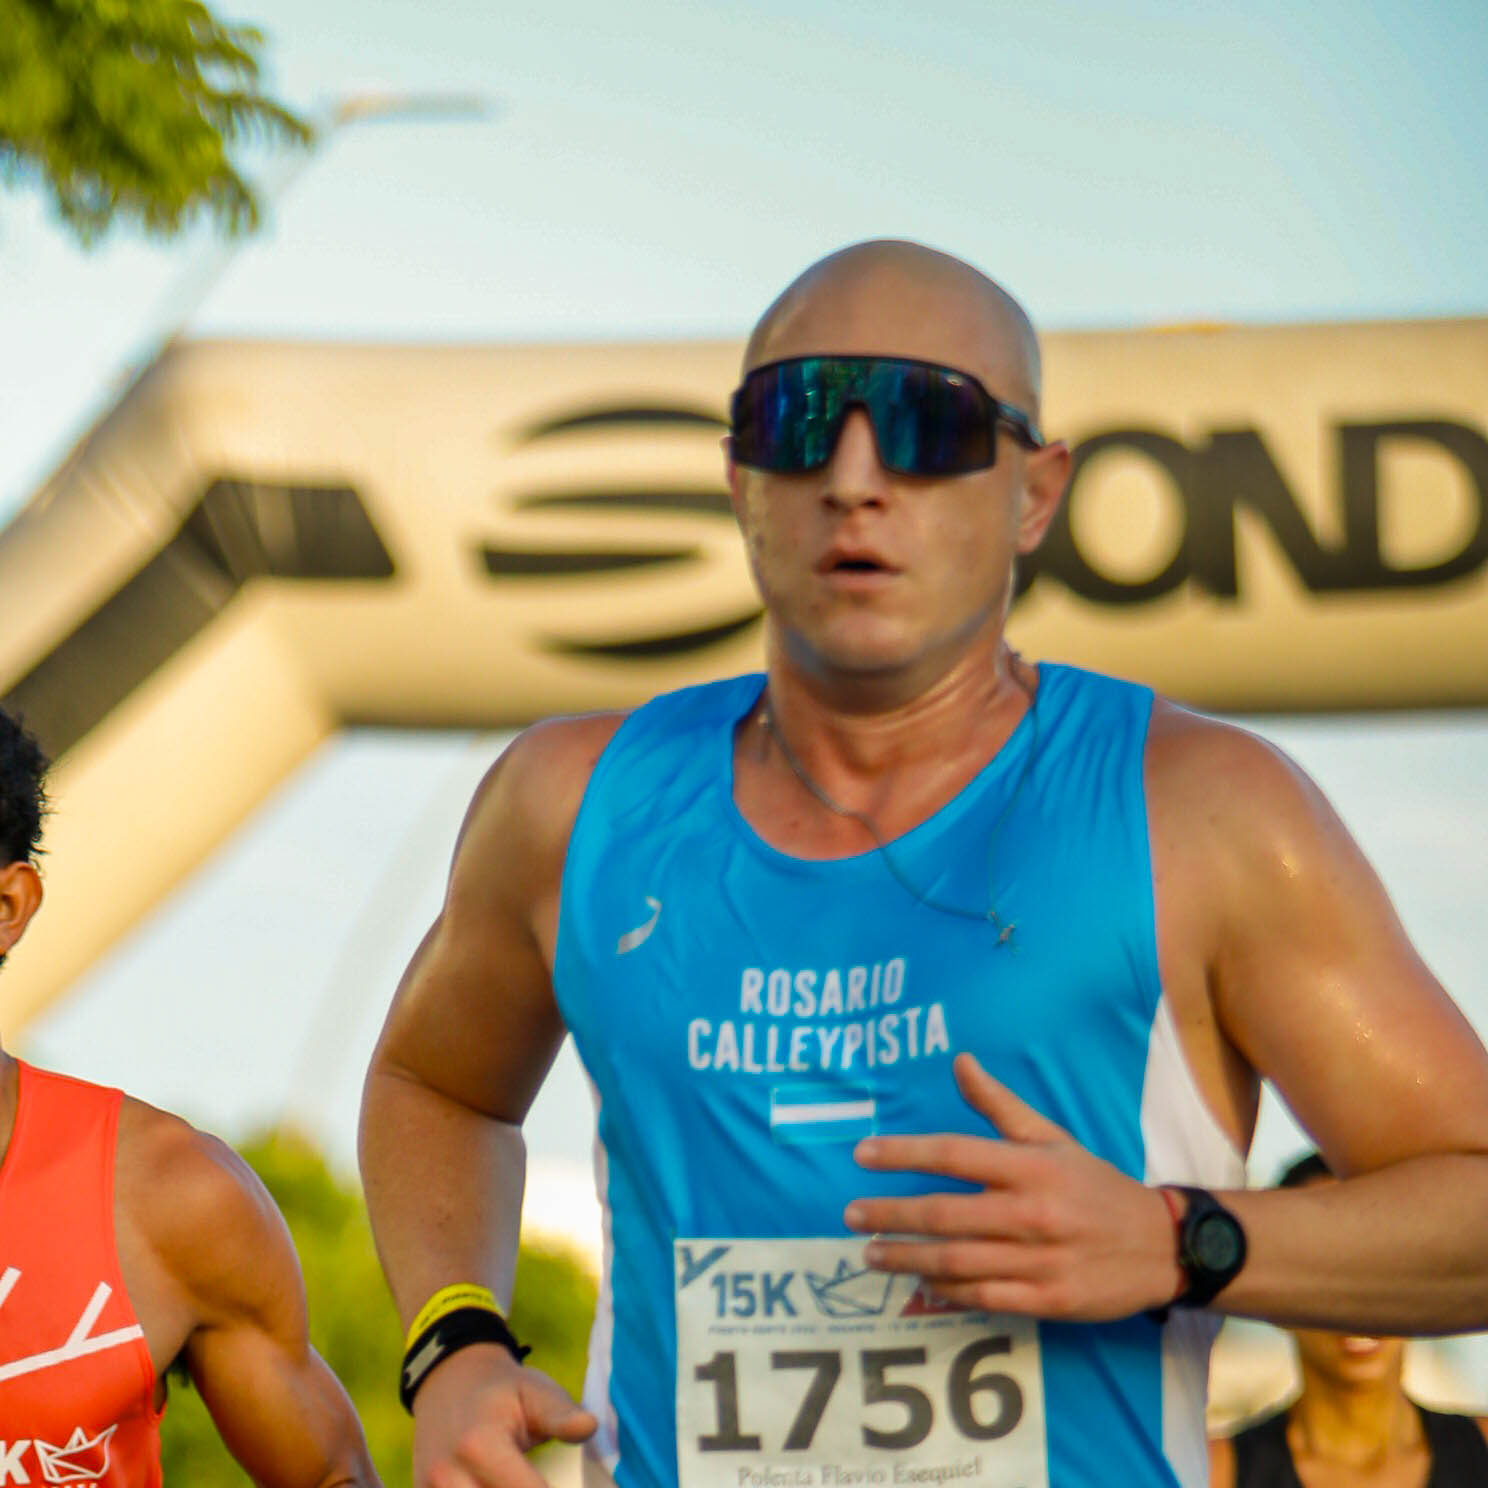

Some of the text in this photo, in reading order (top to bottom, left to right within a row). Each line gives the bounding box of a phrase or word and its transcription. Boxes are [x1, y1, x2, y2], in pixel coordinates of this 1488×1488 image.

[740, 957, 906, 1016] ROSARIO
[688, 1003, 950, 1074] CALLEYPISTA
[710, 1271, 798, 1318] 15K
[694, 1335, 1024, 1452] 1756
[821, 1464, 887, 1486] Flavio
